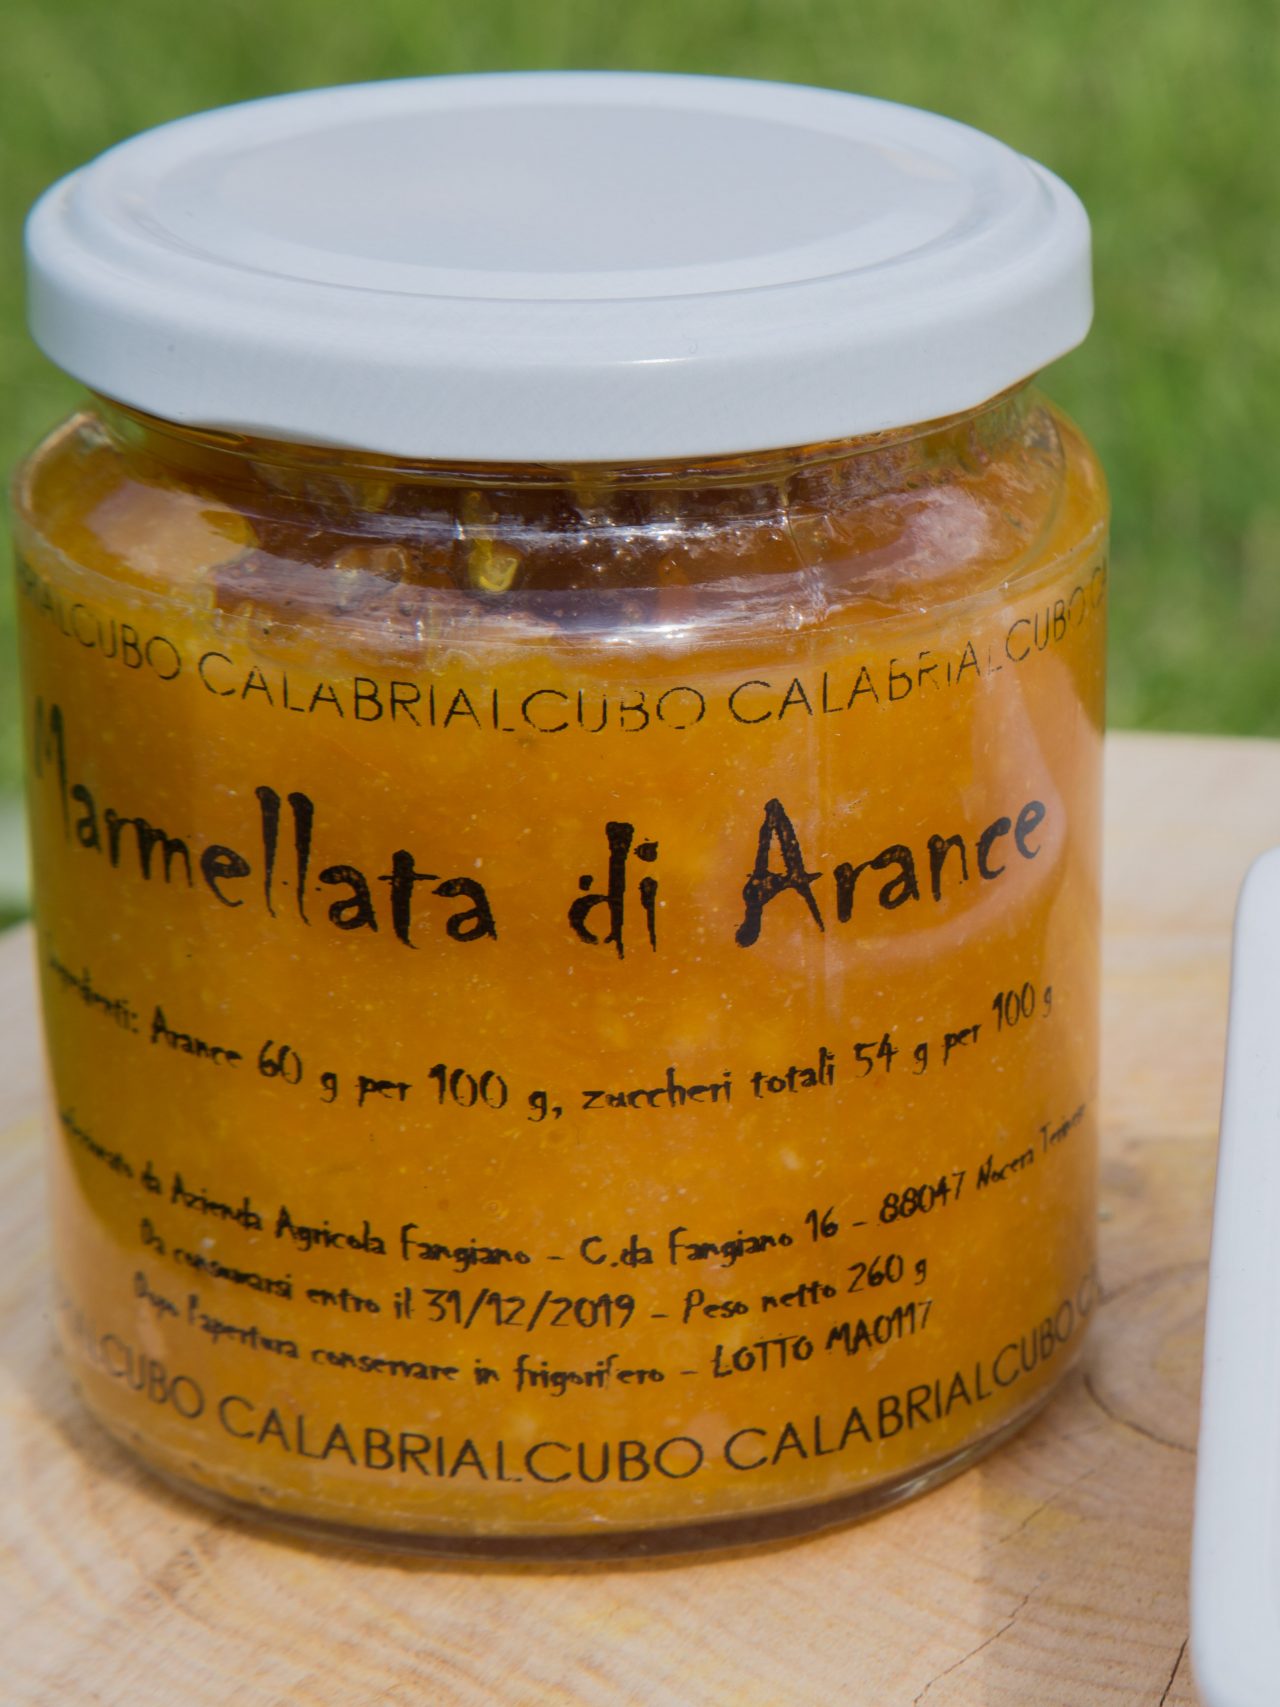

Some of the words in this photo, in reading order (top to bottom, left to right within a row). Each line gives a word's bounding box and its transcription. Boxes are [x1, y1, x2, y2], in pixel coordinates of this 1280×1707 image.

[198, 651, 706, 733] CALABRIALCUBO
[34, 697, 498, 950] Marmellata
[568, 820, 660, 960] di
[734, 797, 1046, 948] Arance
[150, 1004, 243, 1070] Arance
[258, 1039, 303, 1085] 60
[320, 1071, 338, 1104] g
[355, 1074, 413, 1107] per
[428, 1063, 508, 1109] 100
[527, 1089, 563, 1122] g,
[582, 1066, 732, 1110] zuccheri
[751, 1046, 836, 1100] totali
[854, 1032, 899, 1078] 54
[913, 1041, 930, 1076] g
[943, 1023, 983, 1066] per
[992, 982, 1036, 1032] 100
[1041, 985, 1054, 1019] g
[170, 1171, 263, 1231] Azienda
[274, 1205, 388, 1256] Agricola
[401, 1222, 532, 1273] Fangiano
[580, 1234, 655, 1269] C.da
[669, 1226, 794, 1270] Fangiano
[804, 1205, 840, 1242] 16
[878, 1170, 967, 1225] 88047
[976, 1153, 1035, 1192] Nocera
[306, 1286, 381, 1315] entro
[394, 1286, 415, 1321] il
[422, 1287, 636, 1333] 31/12/2019
[683, 1289, 749, 1325] Peso
[761, 1279, 838, 1314] netto
[847, 1253, 905, 1294] 260
[914, 1257, 928, 1287] g
[217, 1395, 706, 1485] CALABRIALCUBO
[724, 1298, 1076, 1473] CALABRIALCUBO
[310, 1348, 460, 1382] conservare
[473, 1357, 500, 1387] in
[513, 1353, 665, 1398] frigorifero
[711, 1333, 815, 1379] LOTTO
